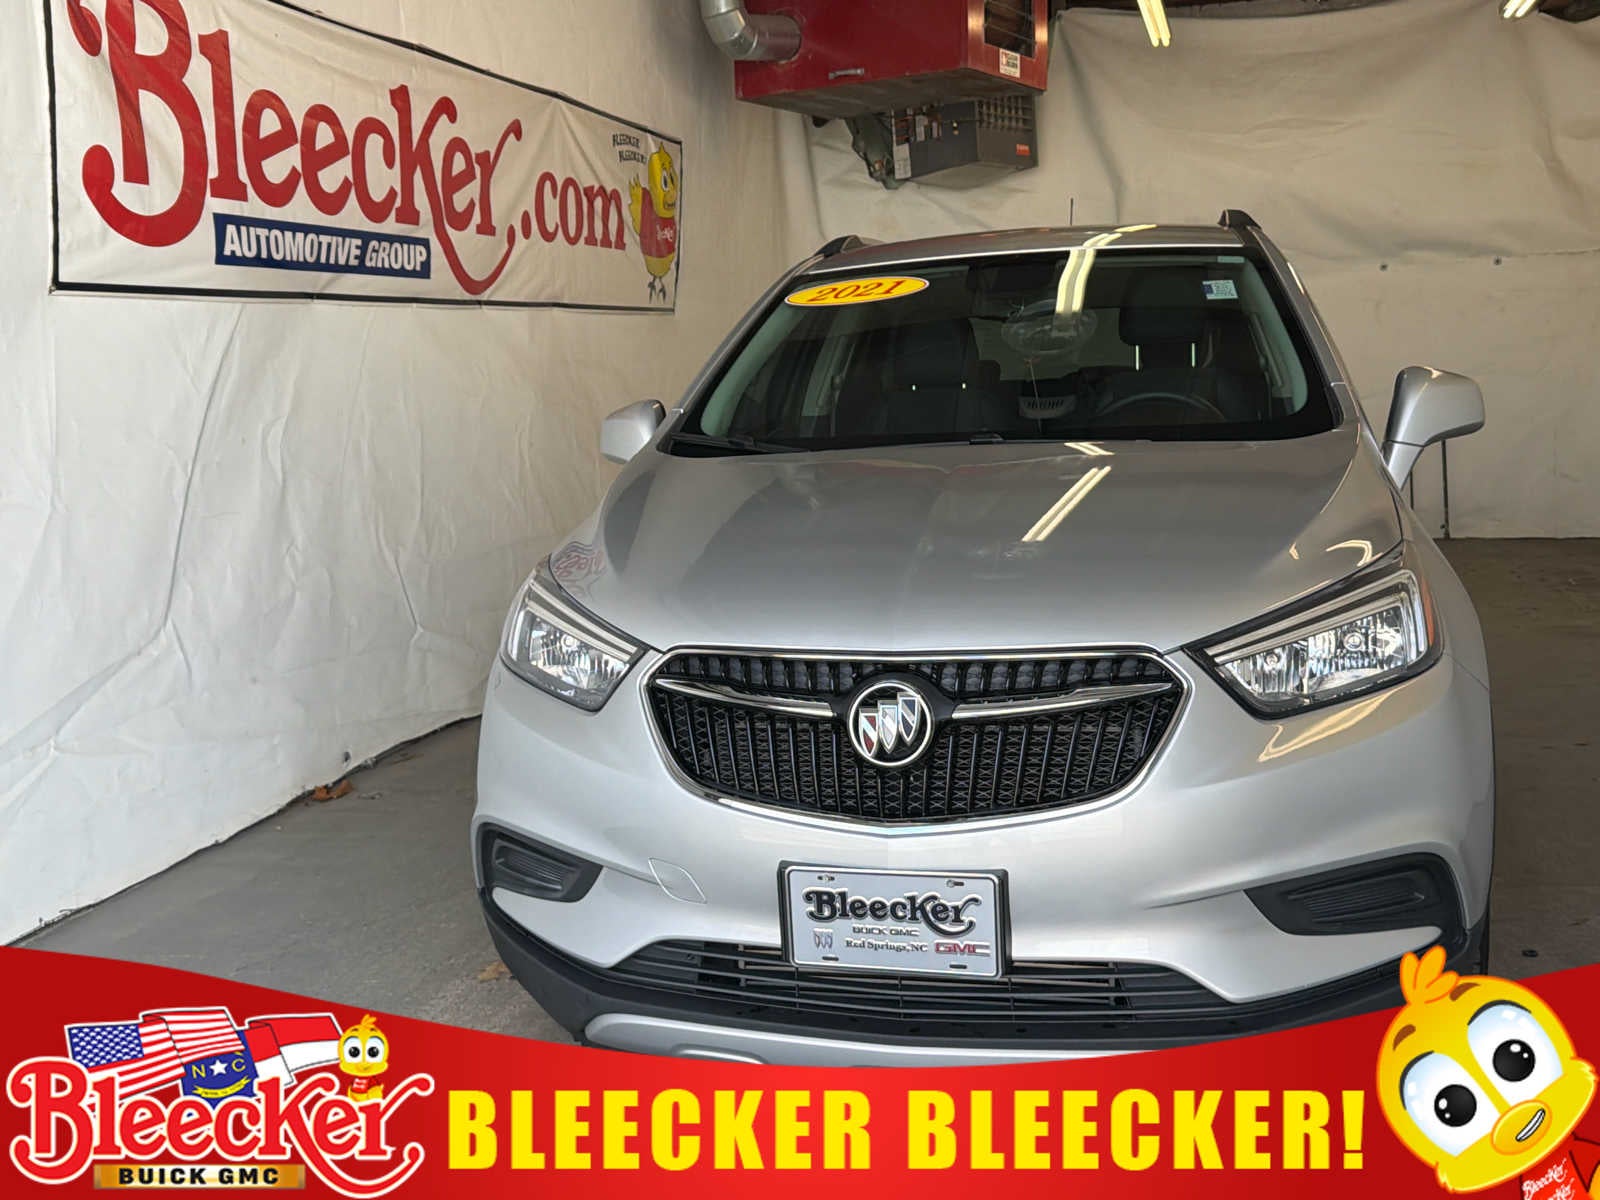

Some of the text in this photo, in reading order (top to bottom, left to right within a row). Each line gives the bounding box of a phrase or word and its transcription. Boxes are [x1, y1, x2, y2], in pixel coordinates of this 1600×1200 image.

[223, 224, 427, 271] AUTOMOTIVE GROUP
[806, 279, 906, 303] 2021
[852, 926, 920, 937] BUICK GMC
[845, 939, 866, 948] Red
[935, 941, 990, 957] GMC
